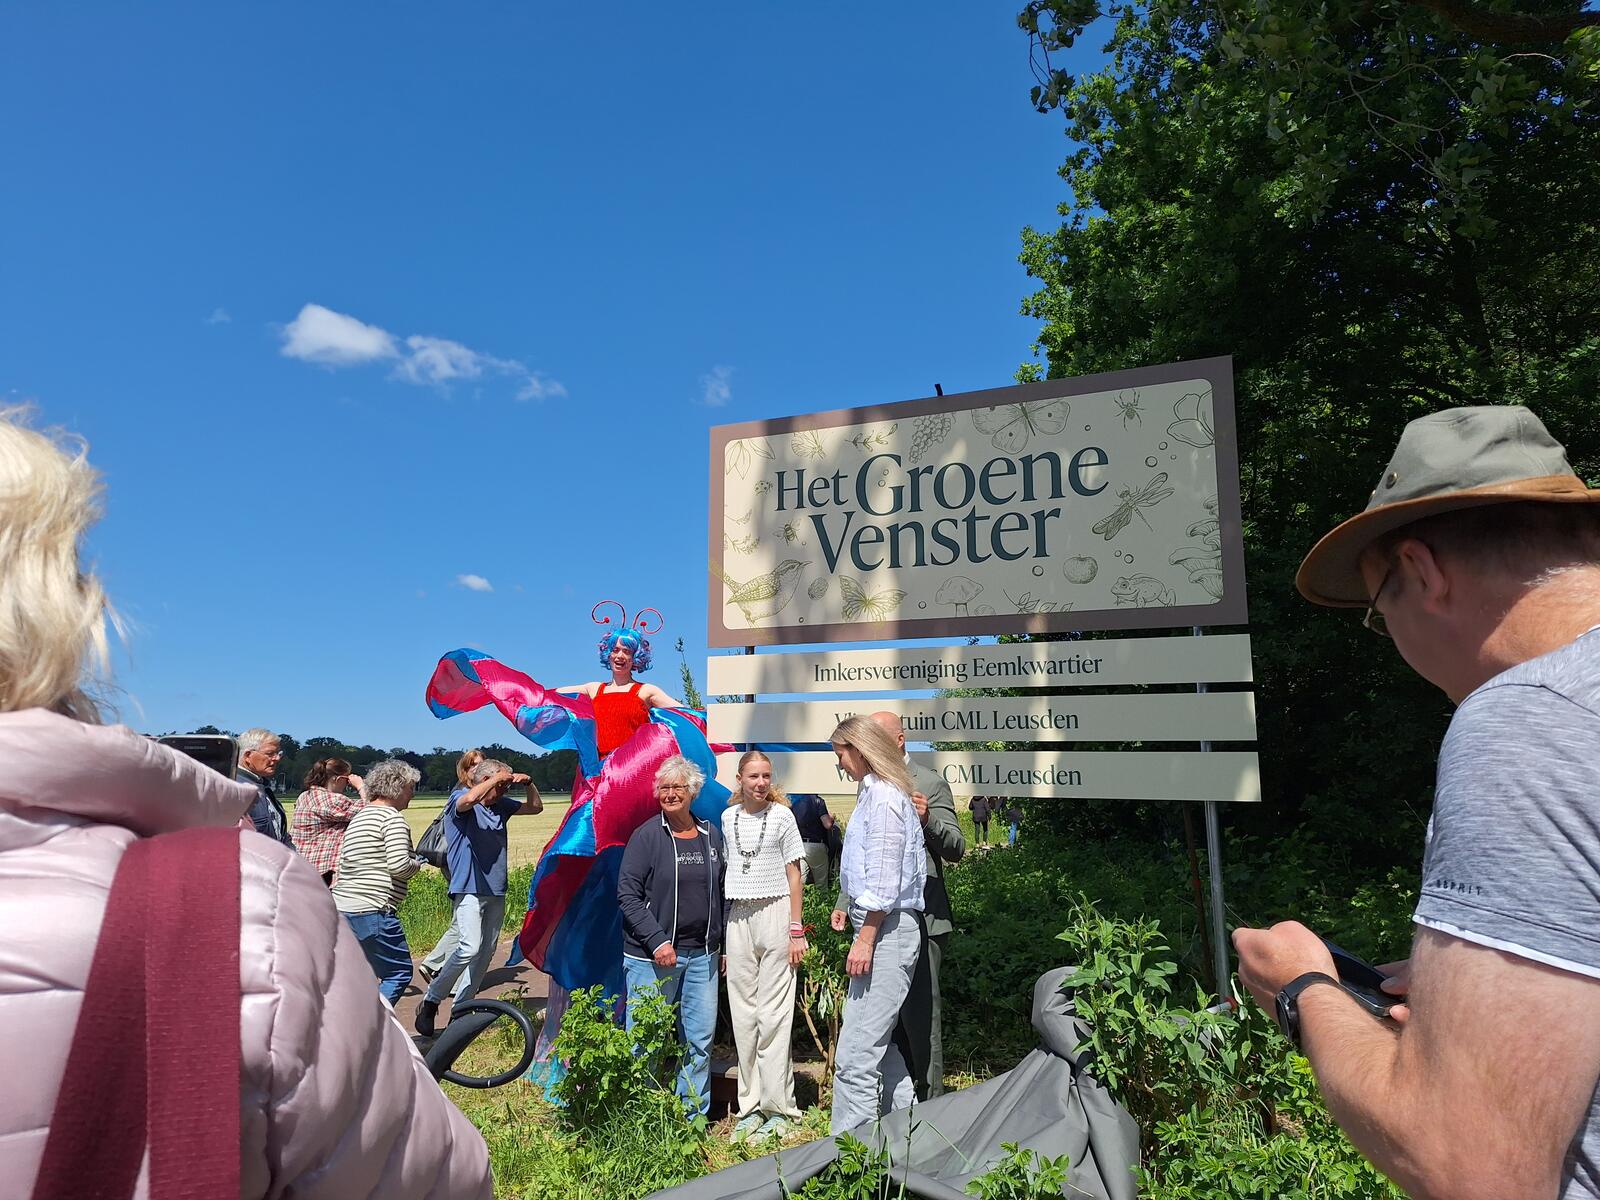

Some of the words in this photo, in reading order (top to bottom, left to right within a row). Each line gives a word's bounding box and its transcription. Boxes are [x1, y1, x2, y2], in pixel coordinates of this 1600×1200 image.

[774, 468, 849, 512] Het
[855, 445, 1110, 517] Groene
[808, 504, 1062, 575] Venster
[814, 659, 968, 684] Imkersvereniging
[972, 654, 1103, 677] Eemkwartier
[941, 710, 988, 731] CML
[992, 708, 1079, 731] Leusden
[942, 764, 990, 785] CML
[995, 764, 1082, 786] Leusden
